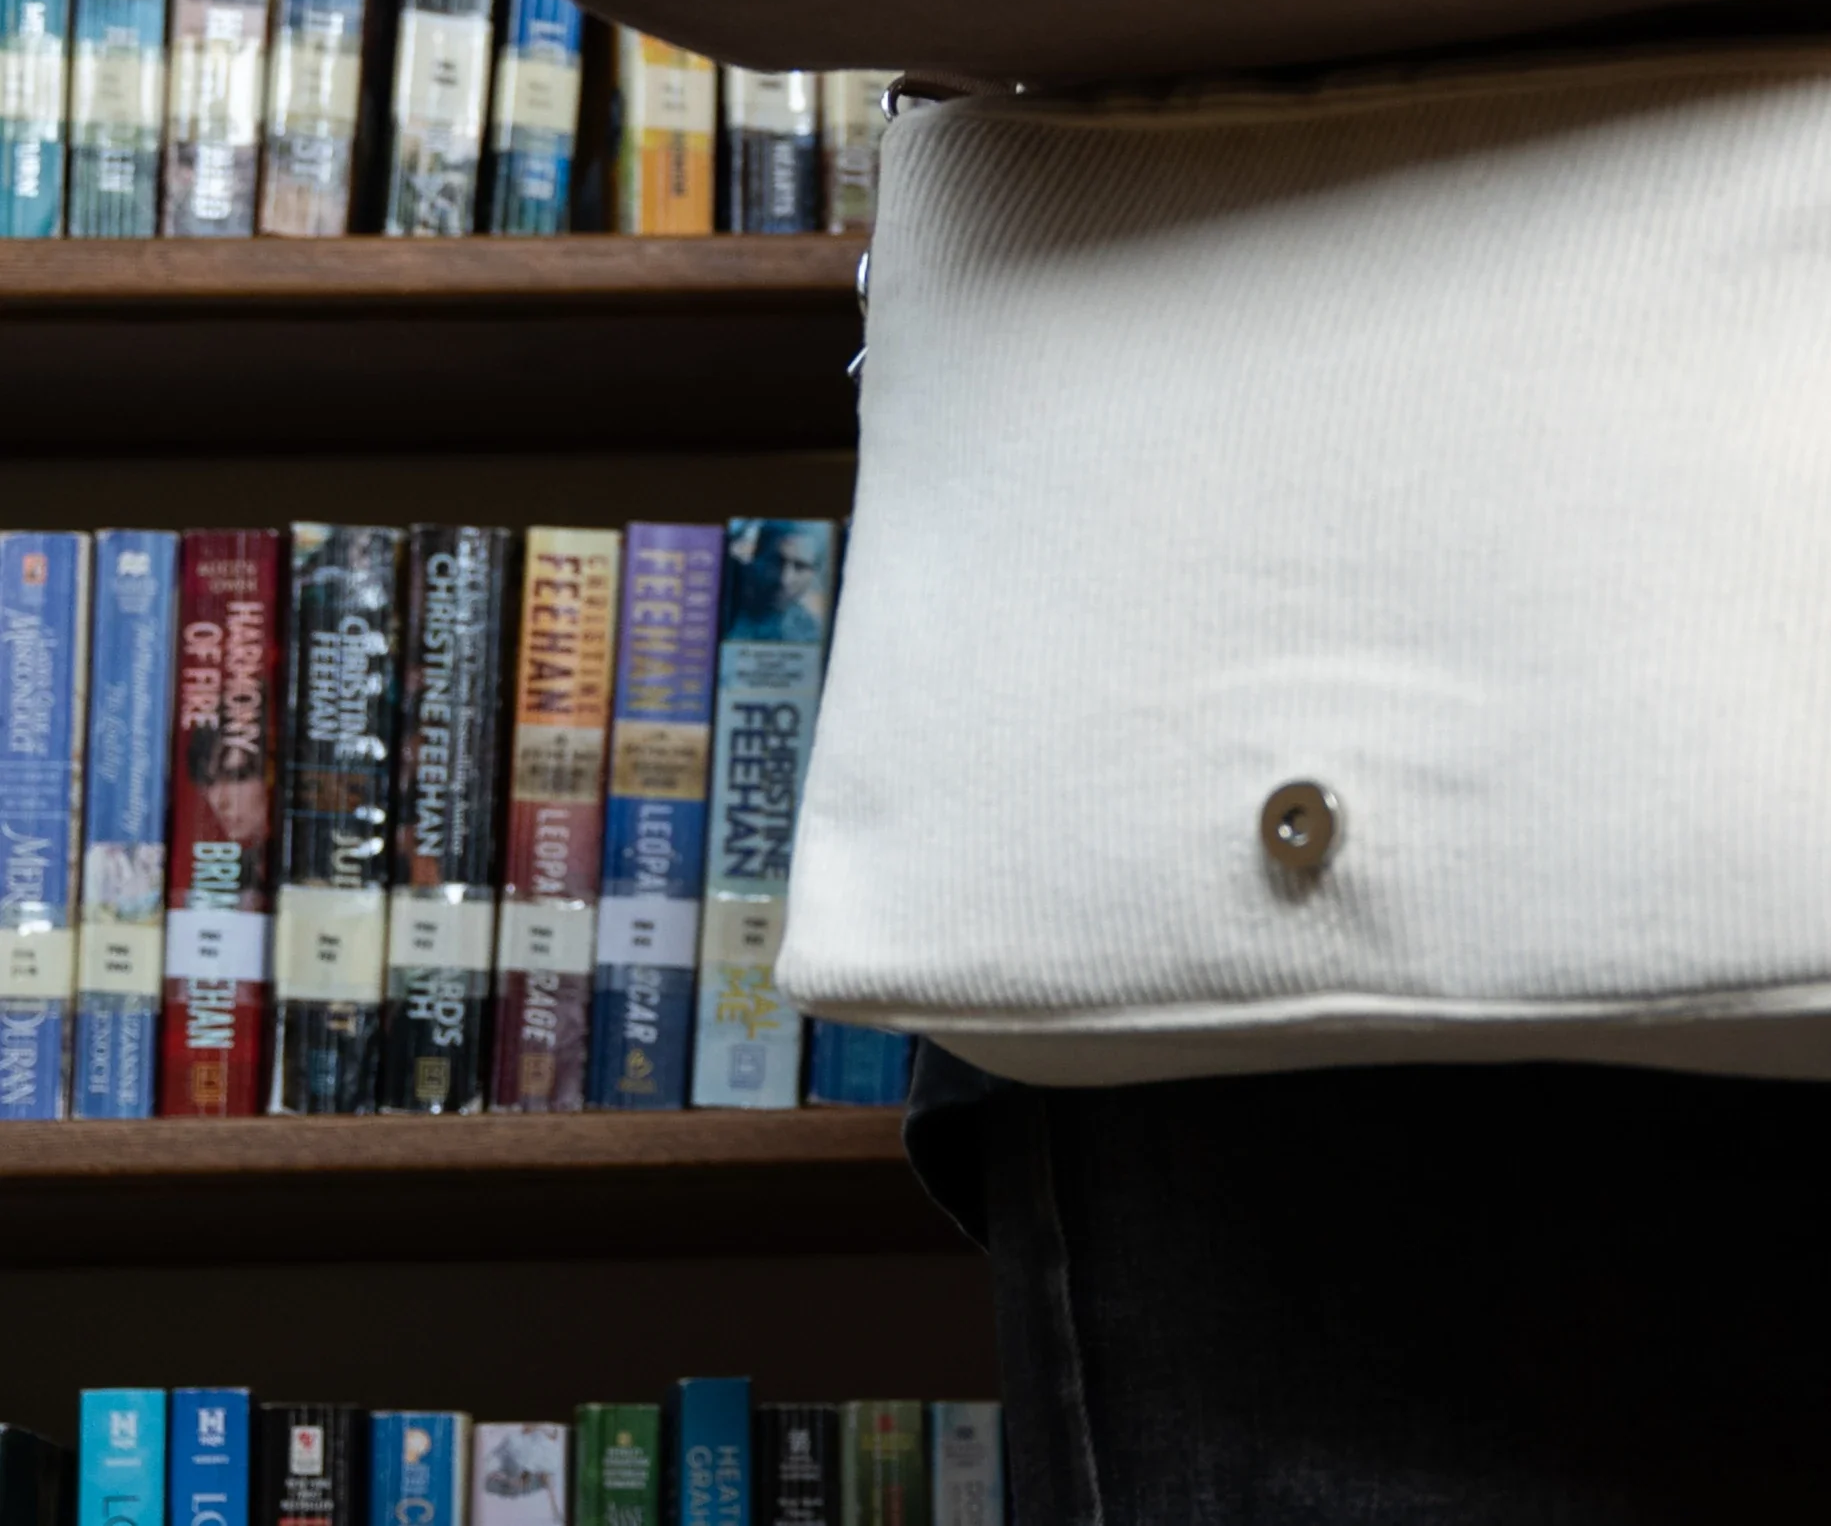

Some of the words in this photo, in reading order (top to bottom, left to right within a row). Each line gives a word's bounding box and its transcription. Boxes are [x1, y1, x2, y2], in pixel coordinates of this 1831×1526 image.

[182, 622, 223, 662] OF
[420, 552, 458, 722] CHRISTINE
[526, 553, 583, 715] FEEHAN
[580, 554, 611, 716] CHRISTINE
[627, 548, 687, 711] FEEHAN
[679, 550, 715, 713] CHRISTINE
[180, 667, 222, 730] FIRE
[222, 600, 266, 754] HARMONY
[308, 631, 342, 741] FEEHAN
[334, 615, 374, 760] CHRISTINE
[415, 726, 452, 857] FEEHAN
[722, 701, 771, 879] FEEHAN
[760, 702, 802, 882] CHRISTINE
[186, 841, 243, 912] BRIA
[532, 807, 572, 897] LEOPA
[635, 803, 675, 897] LEOPA
[184, 978, 237, 1049] EHAN
[432, 969, 466, 1047] ARD'S
[522, 972, 559, 1048] RAGE
[623, 967, 662, 1046] SCAR
[716, 966, 748, 1024] ME
[747, 965, 780, 1040] HAL
[0, 1006, 46, 1105] DURAN
[88, 1011, 112, 1094] ENOCH
[684, 1445, 713, 1526] GRAH
[714, 1445, 743, 1526] HEAT
